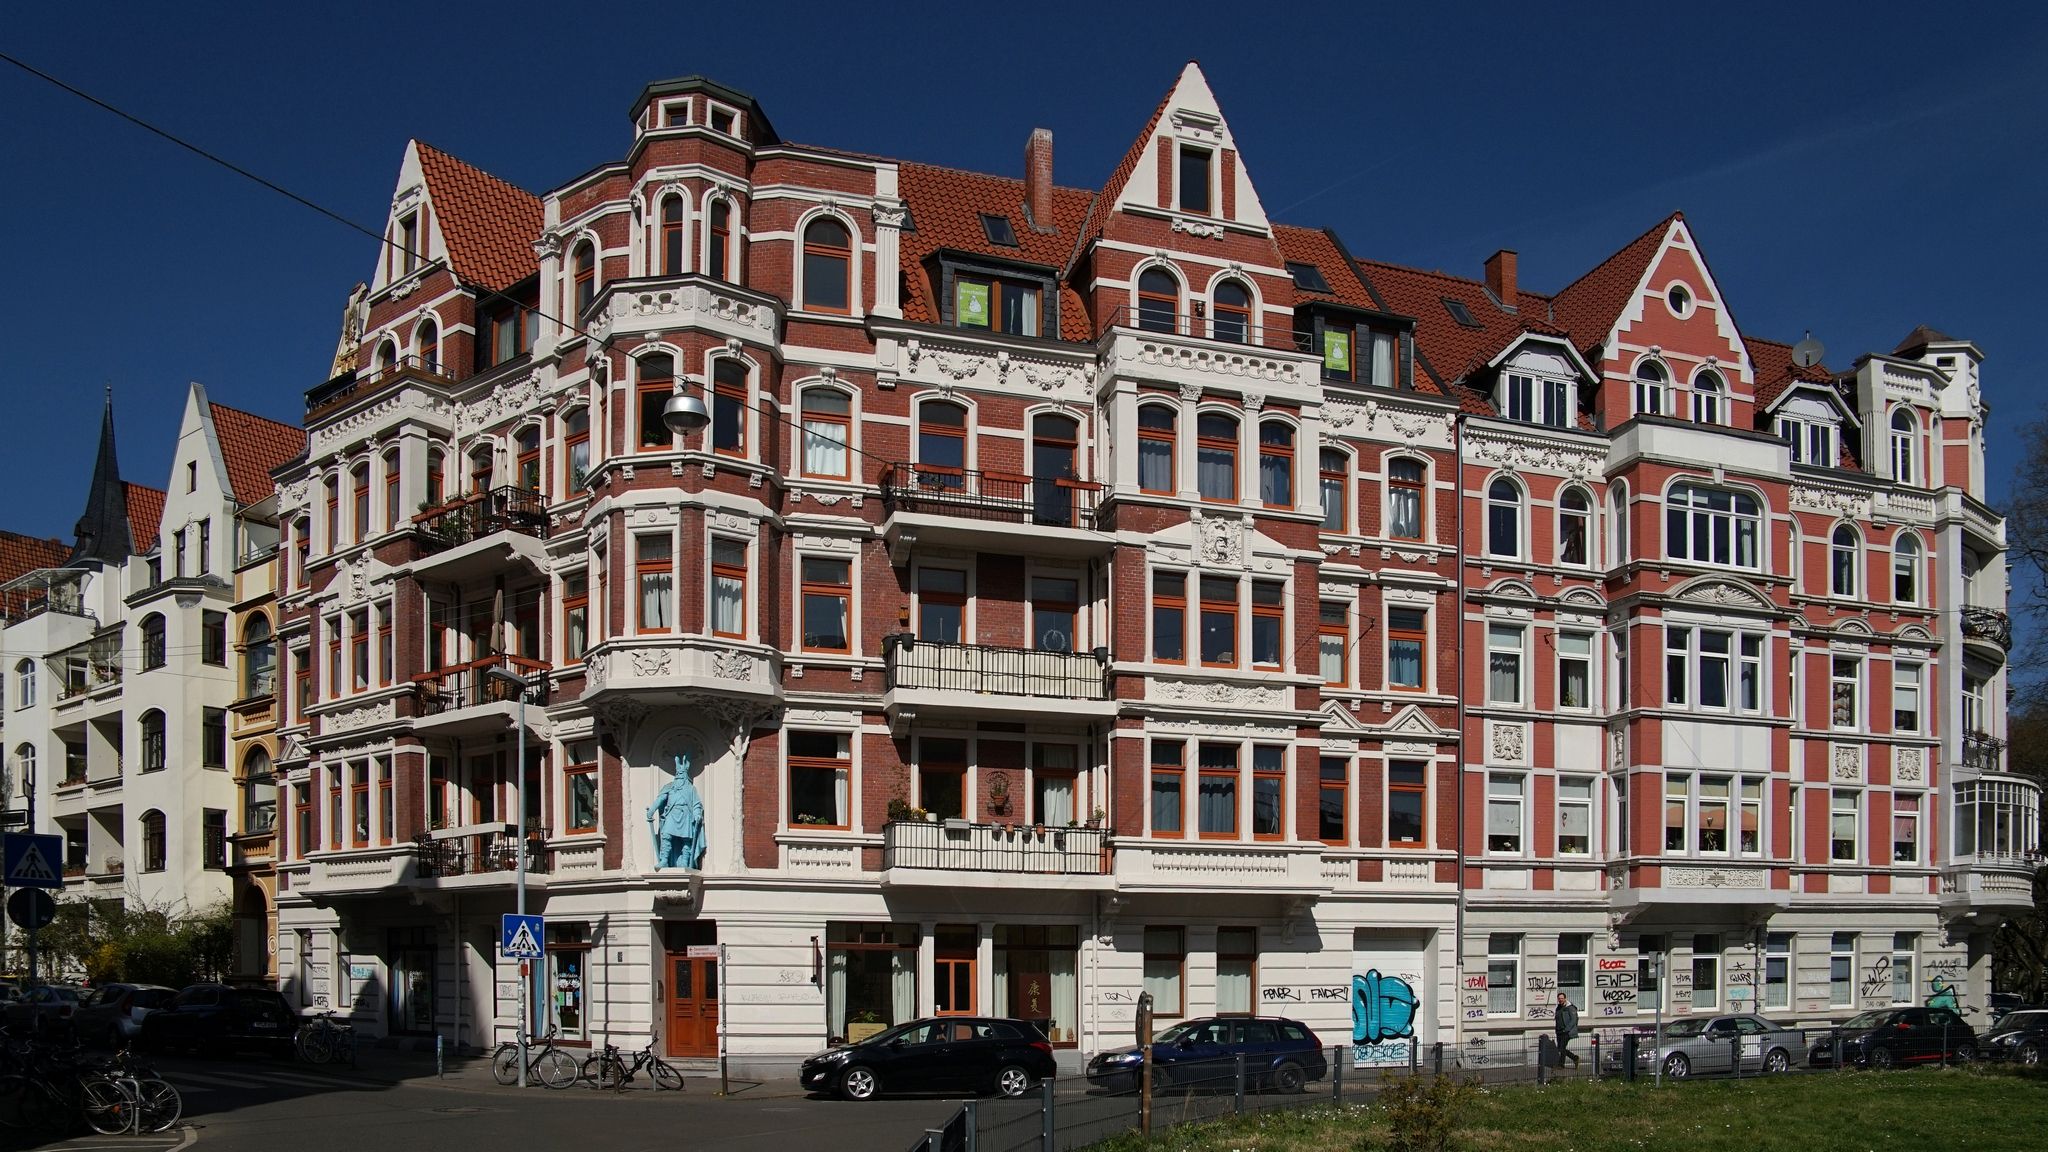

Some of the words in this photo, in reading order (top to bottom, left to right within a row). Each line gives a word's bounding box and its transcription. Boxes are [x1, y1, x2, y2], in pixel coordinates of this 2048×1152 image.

[1464, 975, 1488, 991] VDM
[1595, 973, 1637, 987] EWP!
[1466, 1009, 1484, 1018] 1312
[1603, 1006, 1624, 1016] 1312
